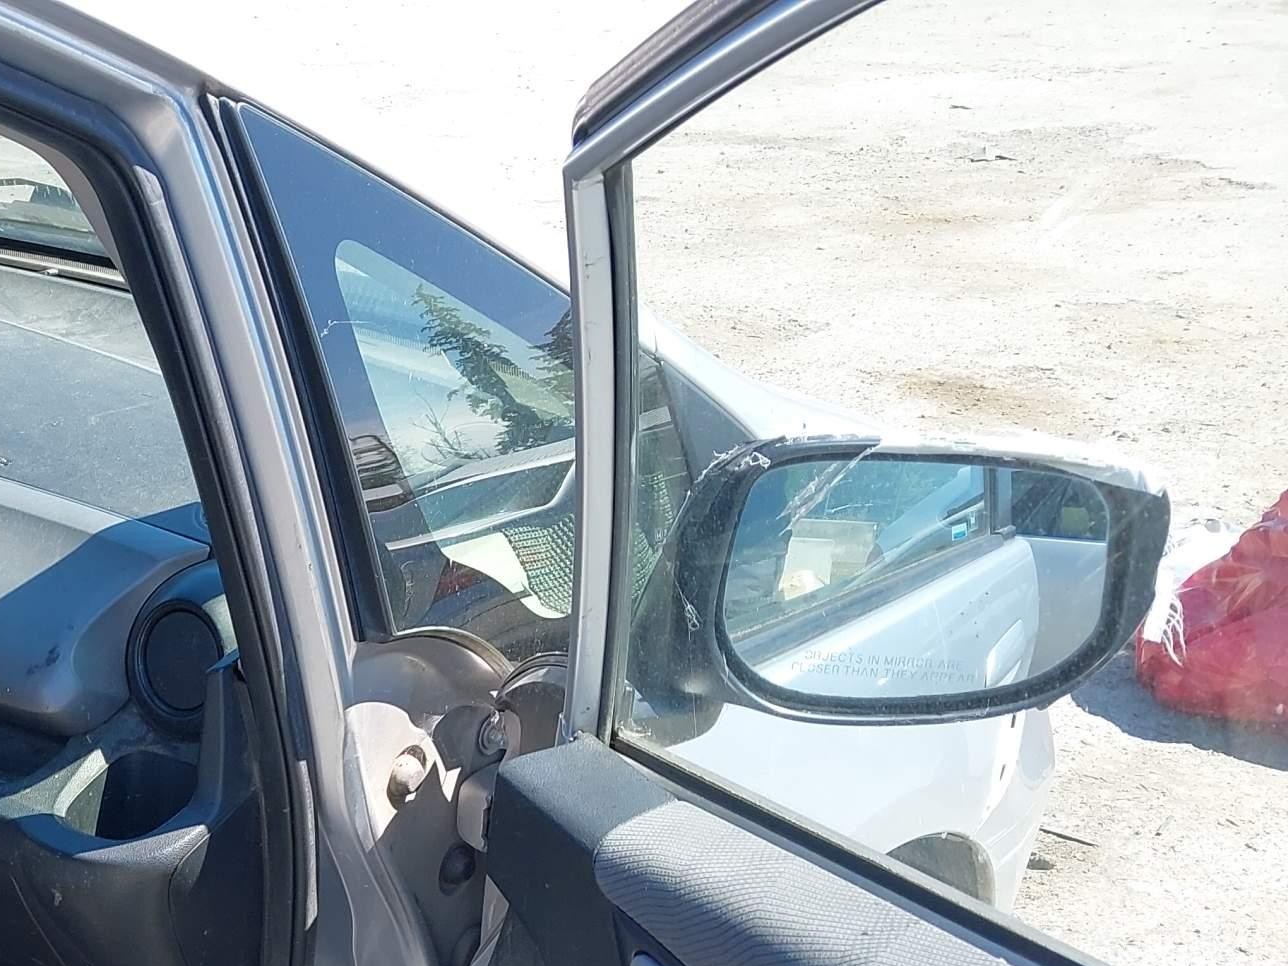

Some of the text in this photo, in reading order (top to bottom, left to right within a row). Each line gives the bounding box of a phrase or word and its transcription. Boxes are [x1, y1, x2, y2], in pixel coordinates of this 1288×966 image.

[804, 649, 961, 671] OBJECTS IN MIRROR ARE
[791, 661, 976, 683] CLOSER THAN THEY APPEAR
